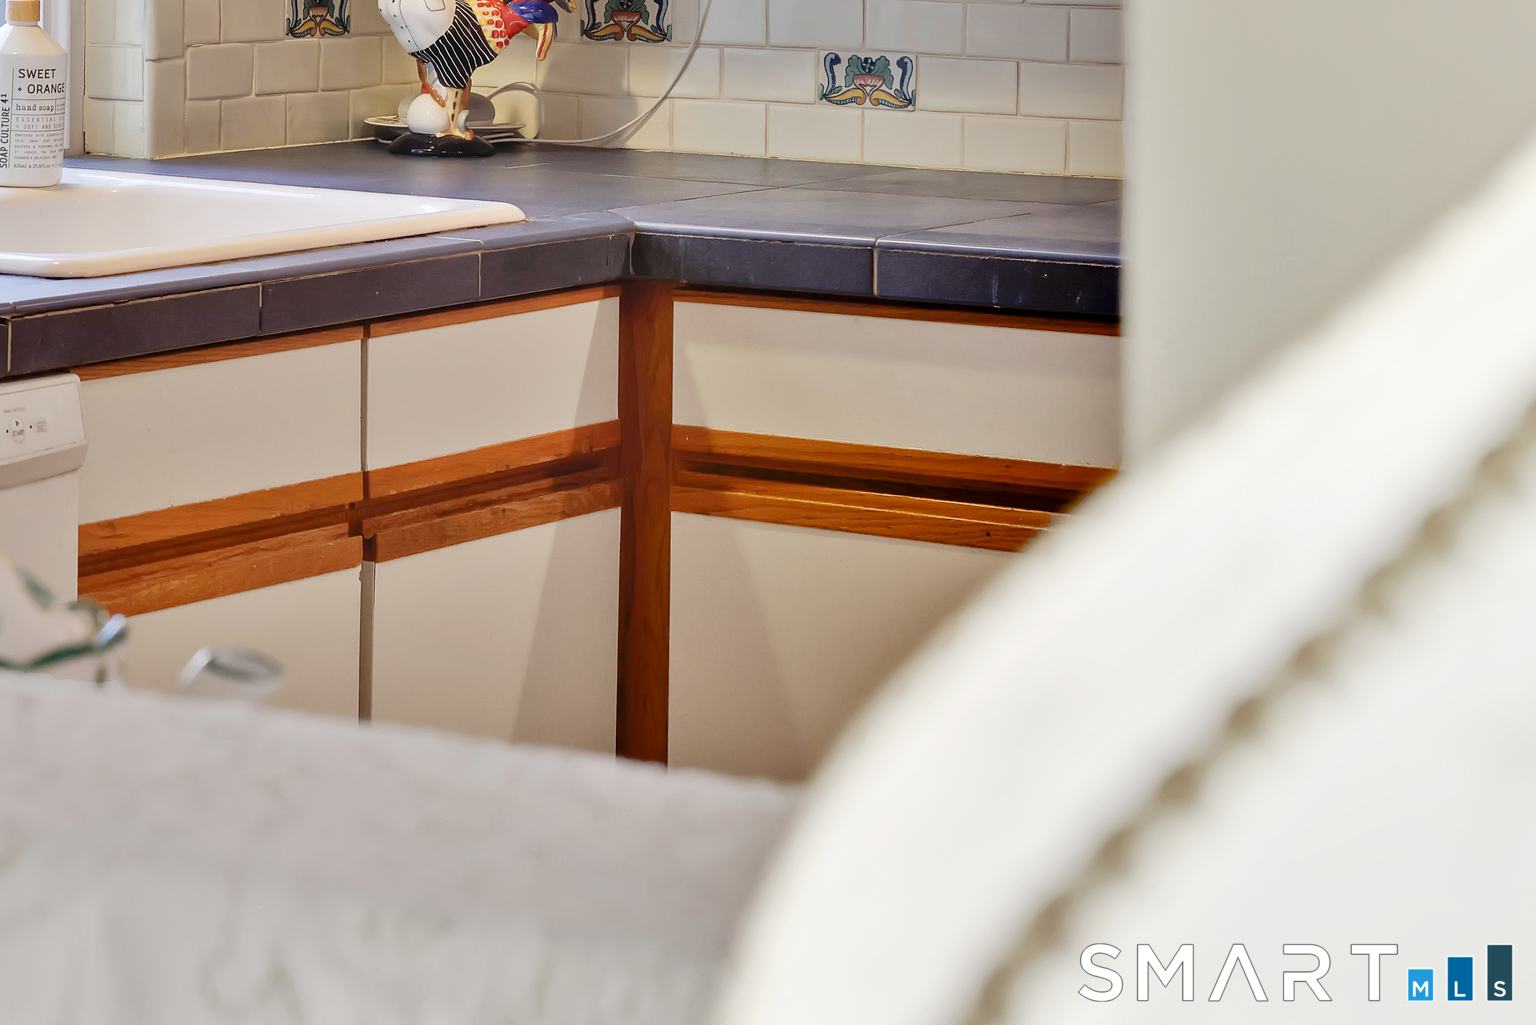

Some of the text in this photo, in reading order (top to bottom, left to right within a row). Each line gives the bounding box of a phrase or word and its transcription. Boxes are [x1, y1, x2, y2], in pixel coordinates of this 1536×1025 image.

[18, 68, 56, 79] SWEET
[27, 82, 65, 94] ORANGE
[15, 103, 37, 111] hand
[38, 105, 55, 113] soap
[0, 107, 10, 144] CULTURE
[0, 148, 8, 169] SOAP
